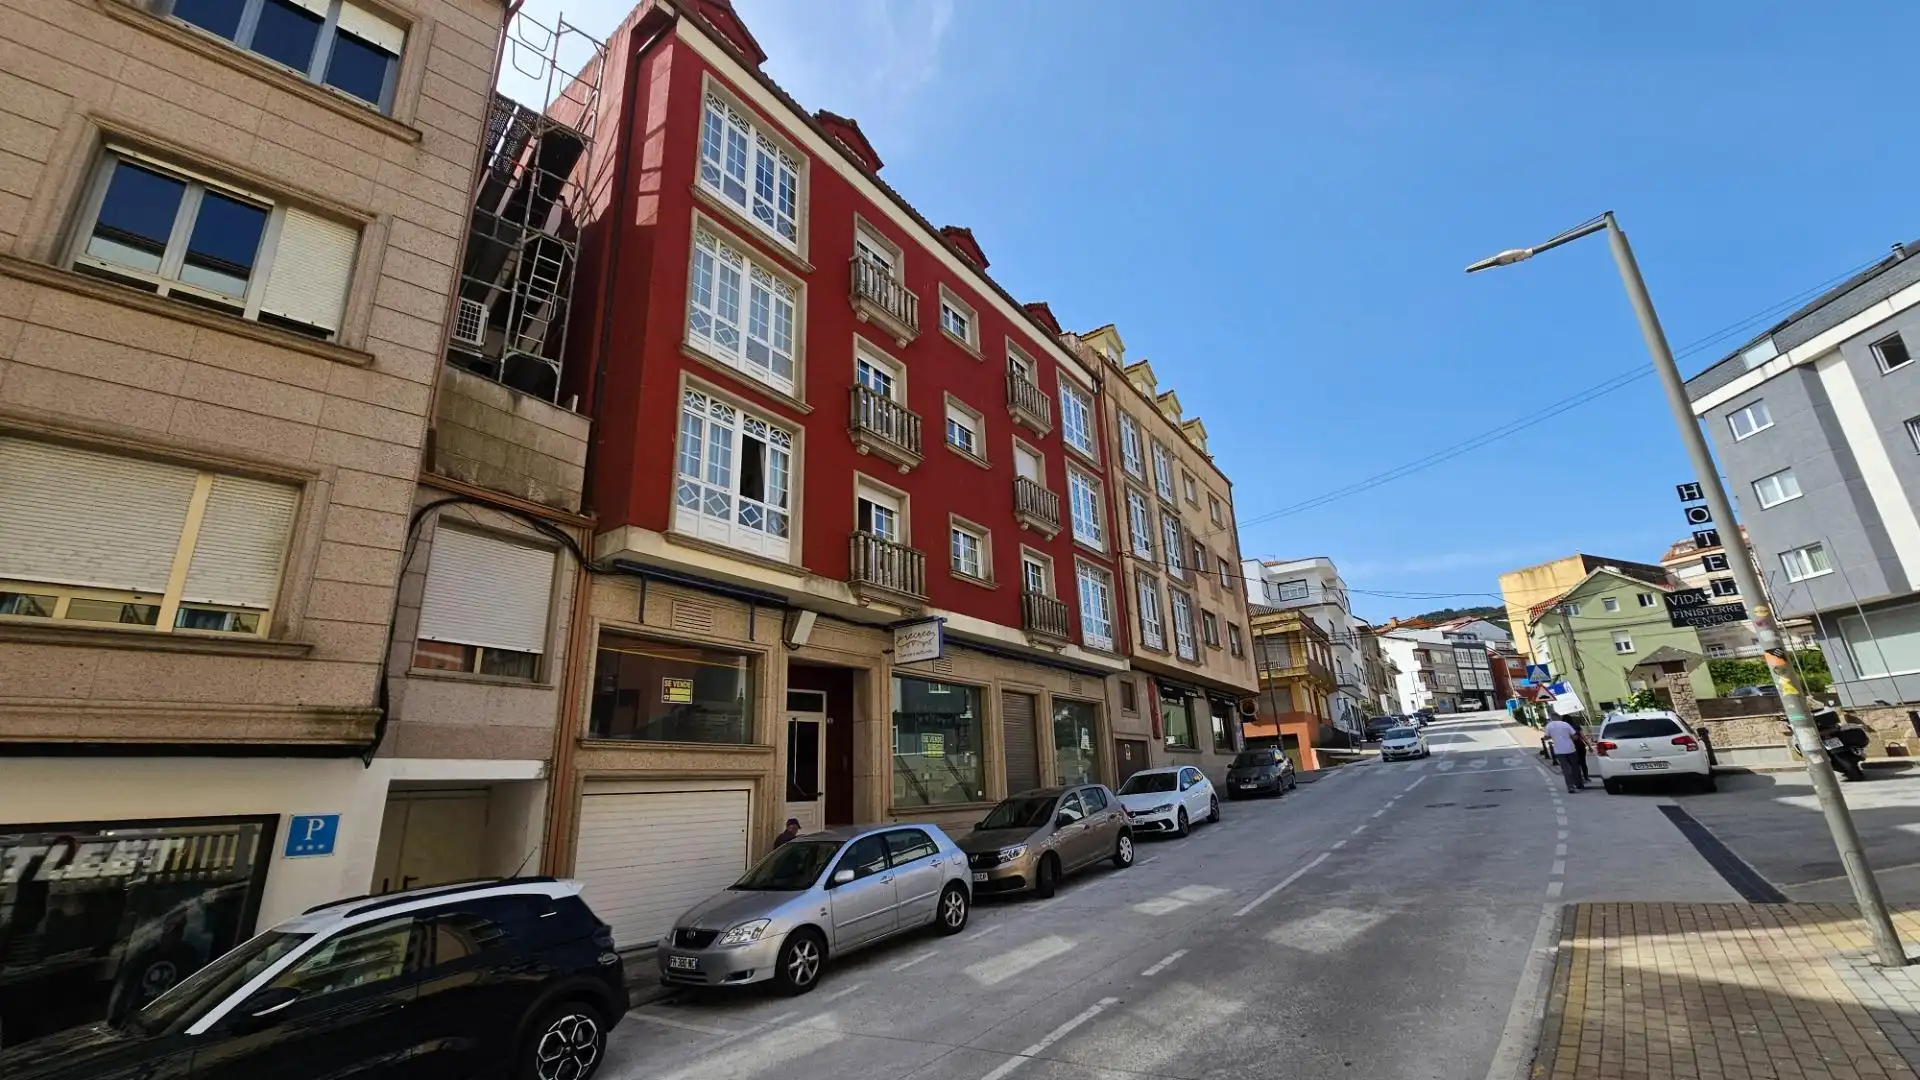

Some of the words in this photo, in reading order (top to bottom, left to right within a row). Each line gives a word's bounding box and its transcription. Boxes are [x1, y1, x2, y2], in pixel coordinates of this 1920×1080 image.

[1679, 484, 1734, 596] HOTEL
[1672, 604, 1742, 619] FINISTERRE
[1686, 613, 1734, 626] CENTRO
[304, 818, 325, 841] P
